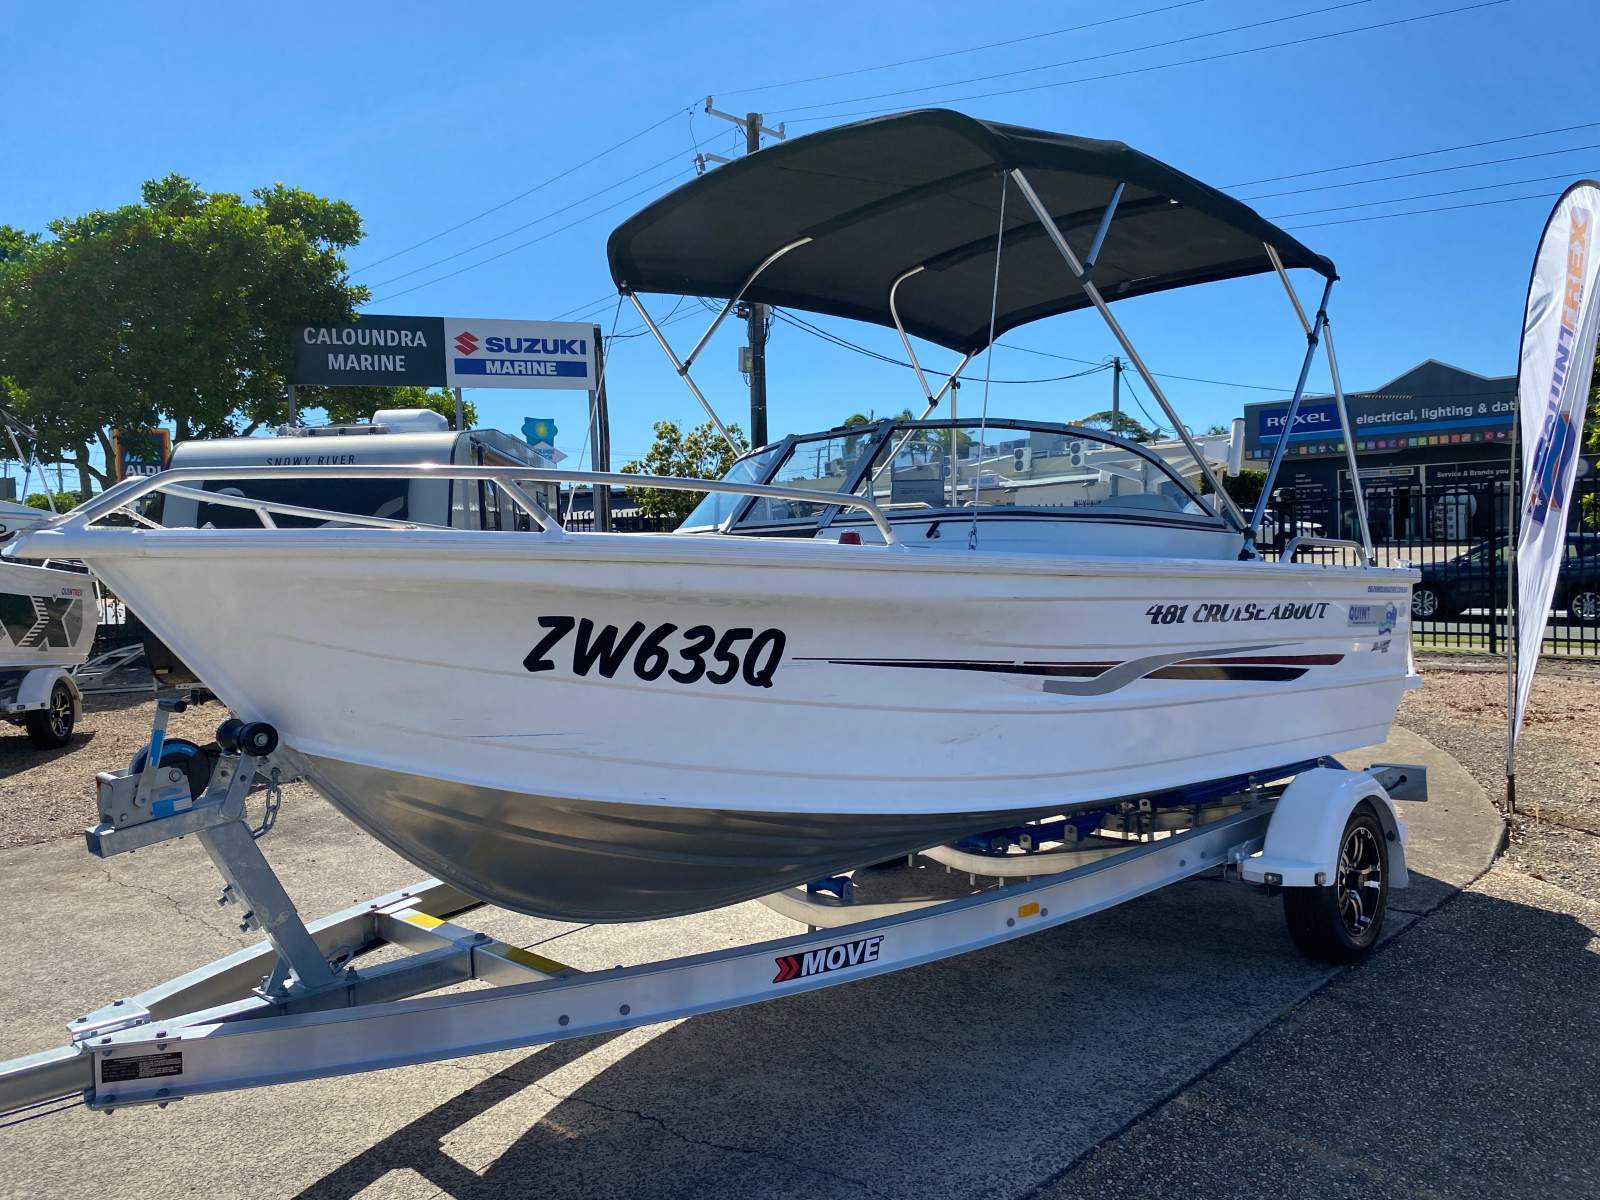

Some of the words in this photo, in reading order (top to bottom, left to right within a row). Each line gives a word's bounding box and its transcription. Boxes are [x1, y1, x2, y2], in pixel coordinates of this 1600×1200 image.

[303, 327, 427, 348] CALOUNDRA
[485, 336, 587, 355] SUZUKI
[327, 354, 406, 372] MARINE
[485, 361, 557, 375] MARINE
[1356, 410, 1418, 426] electrical,
[1421, 404, 1473, 421] lighting
[1478, 402, 1488, 414] &
[1492, 399, 1516, 413] dat
[125, 464, 162, 476] ALDI
[264, 456, 312, 466] SNOWY
[317, 454, 356, 465] RIVER
[1145, 603, 1189, 625] 481
[523, 615, 787, 688] ZW635Q
[800, 936, 881, 977] MOVE
